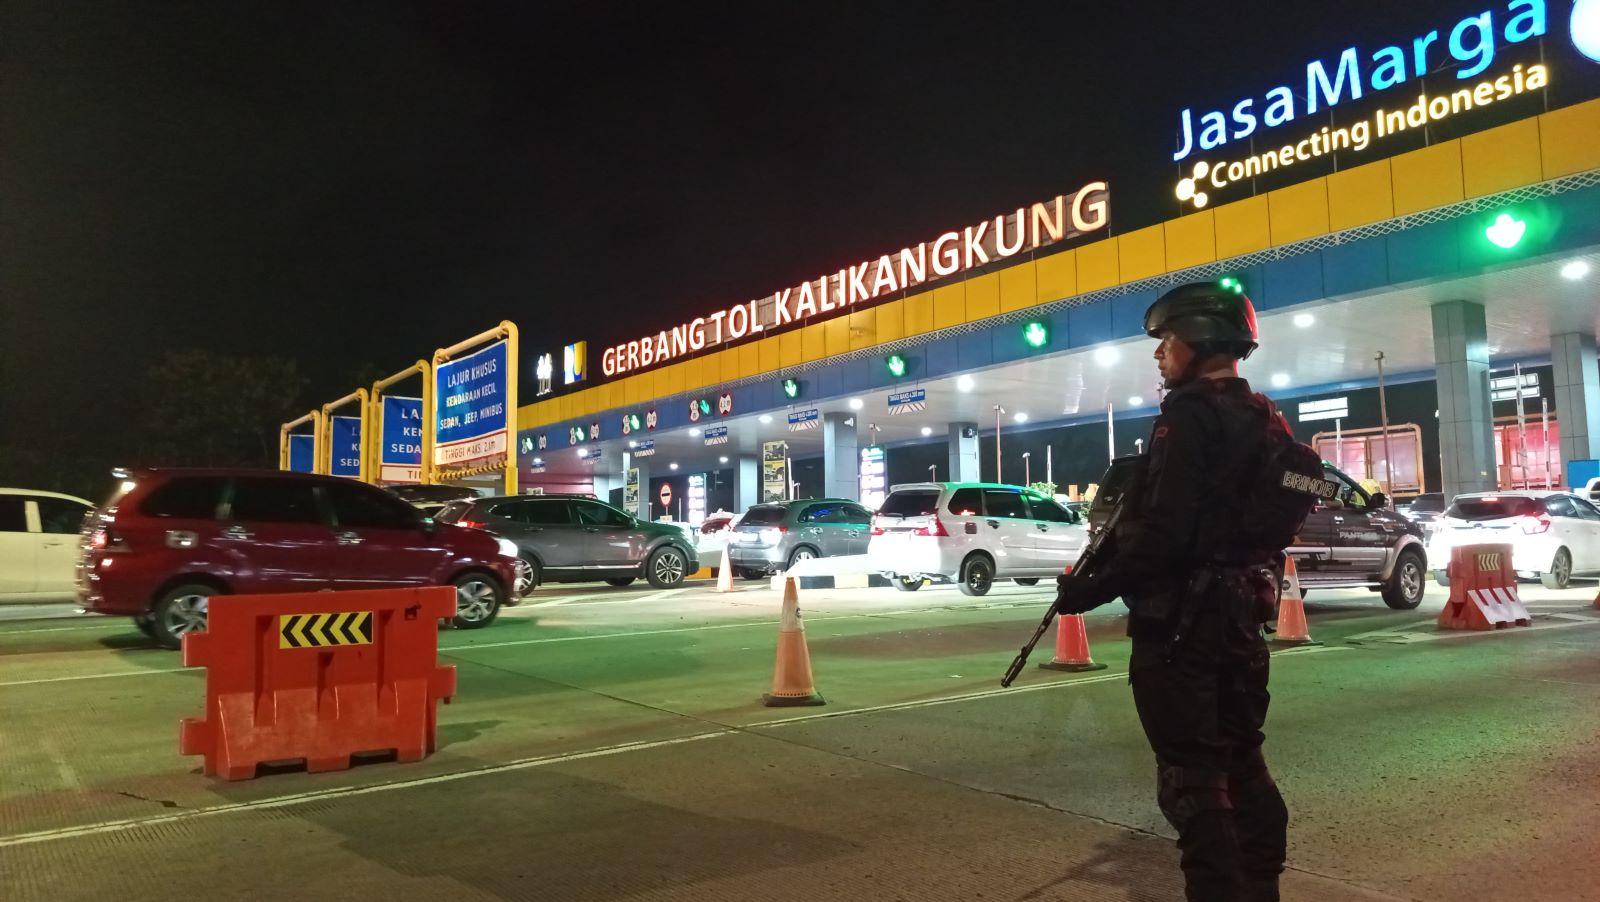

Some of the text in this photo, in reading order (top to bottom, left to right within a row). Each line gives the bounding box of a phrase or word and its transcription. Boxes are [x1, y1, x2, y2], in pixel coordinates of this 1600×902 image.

[1210, 63, 1549, 188] Connecting Indonesia
[602, 181, 1108, 376] GERBANG TOL KALIKANGKUNG
[447, 359, 497, 388] LAJUR KHUSUS
[446, 382, 496, 408] KENDARAAN KECIL
[401, 407, 423, 419] LA
[480, 402, 503, 419] MINIBUS
[445, 447, 465, 460] TINGGI
